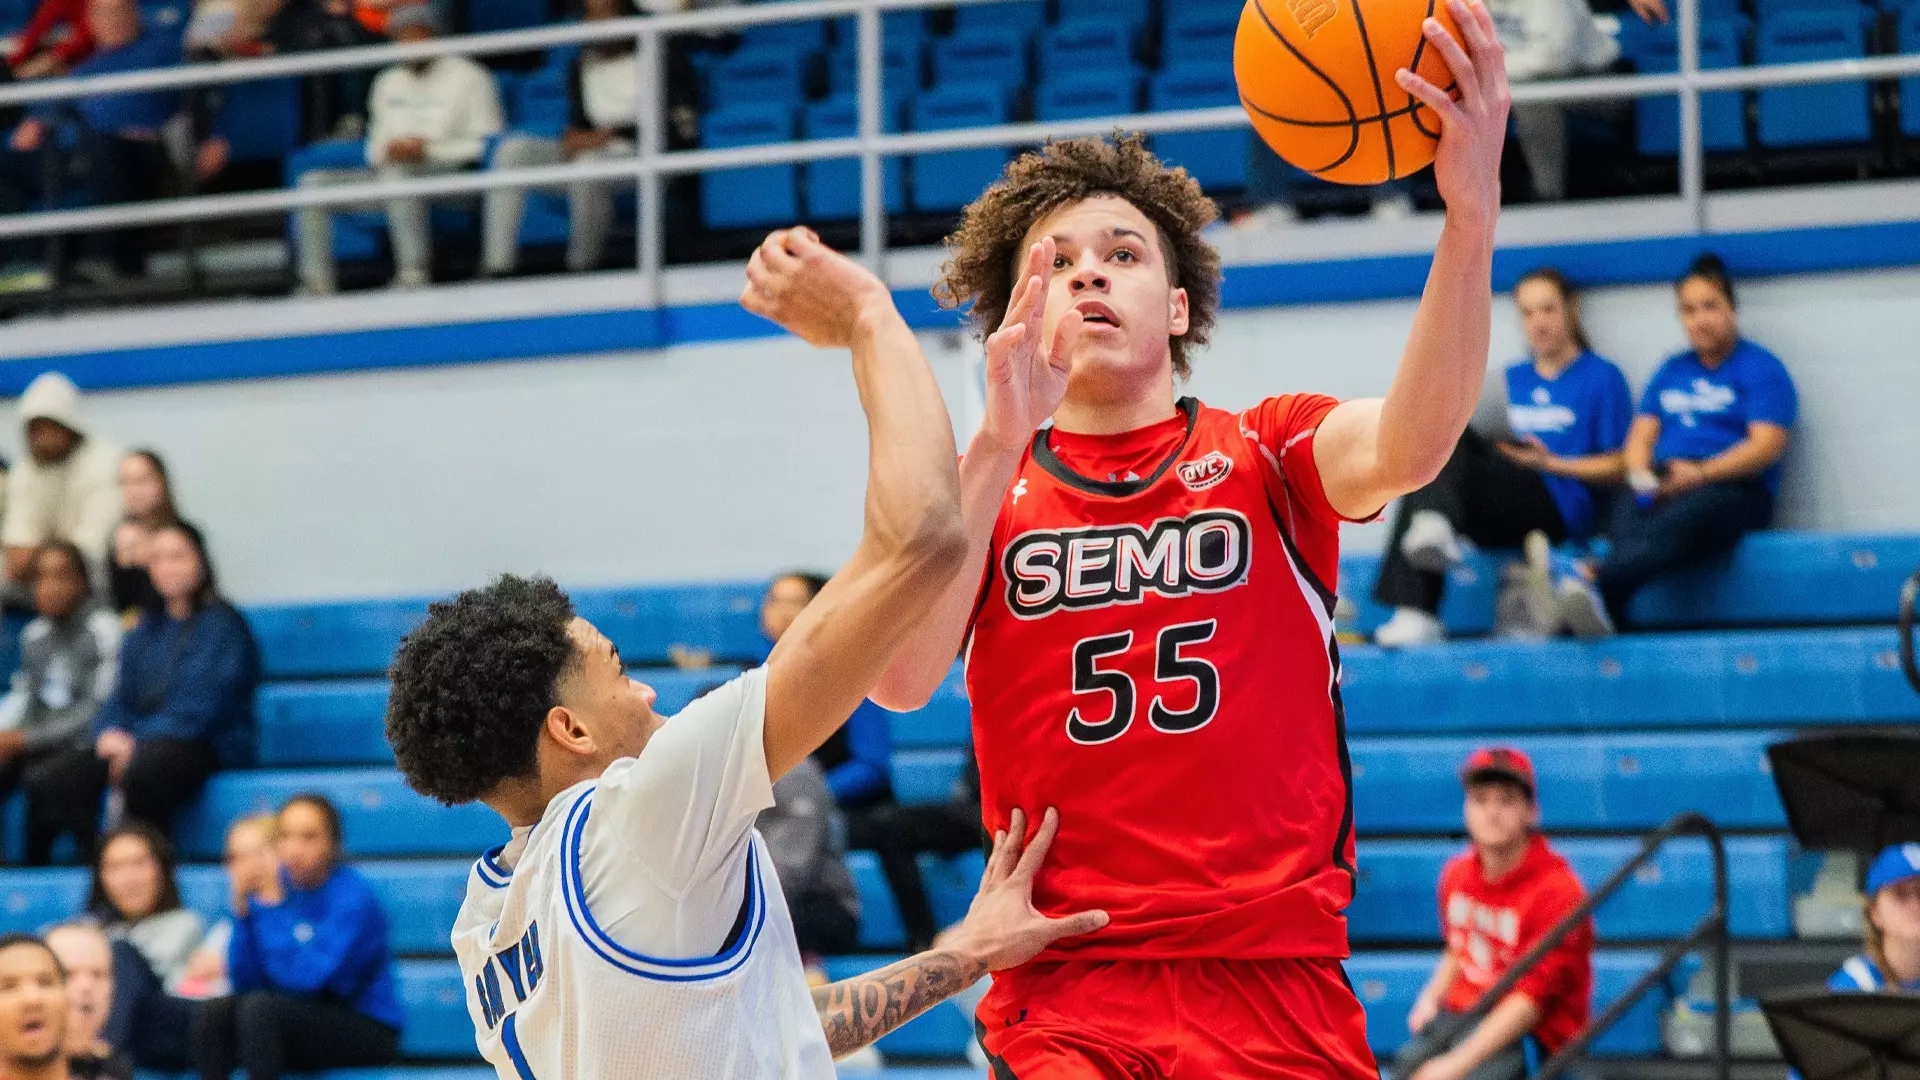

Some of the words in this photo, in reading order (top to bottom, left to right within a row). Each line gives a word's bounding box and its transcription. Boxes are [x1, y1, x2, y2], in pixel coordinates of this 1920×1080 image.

[1184, 458, 1220, 482] OVC
[1008, 513, 1246, 614] SEMO
[1066, 618, 1220, 745] 55
